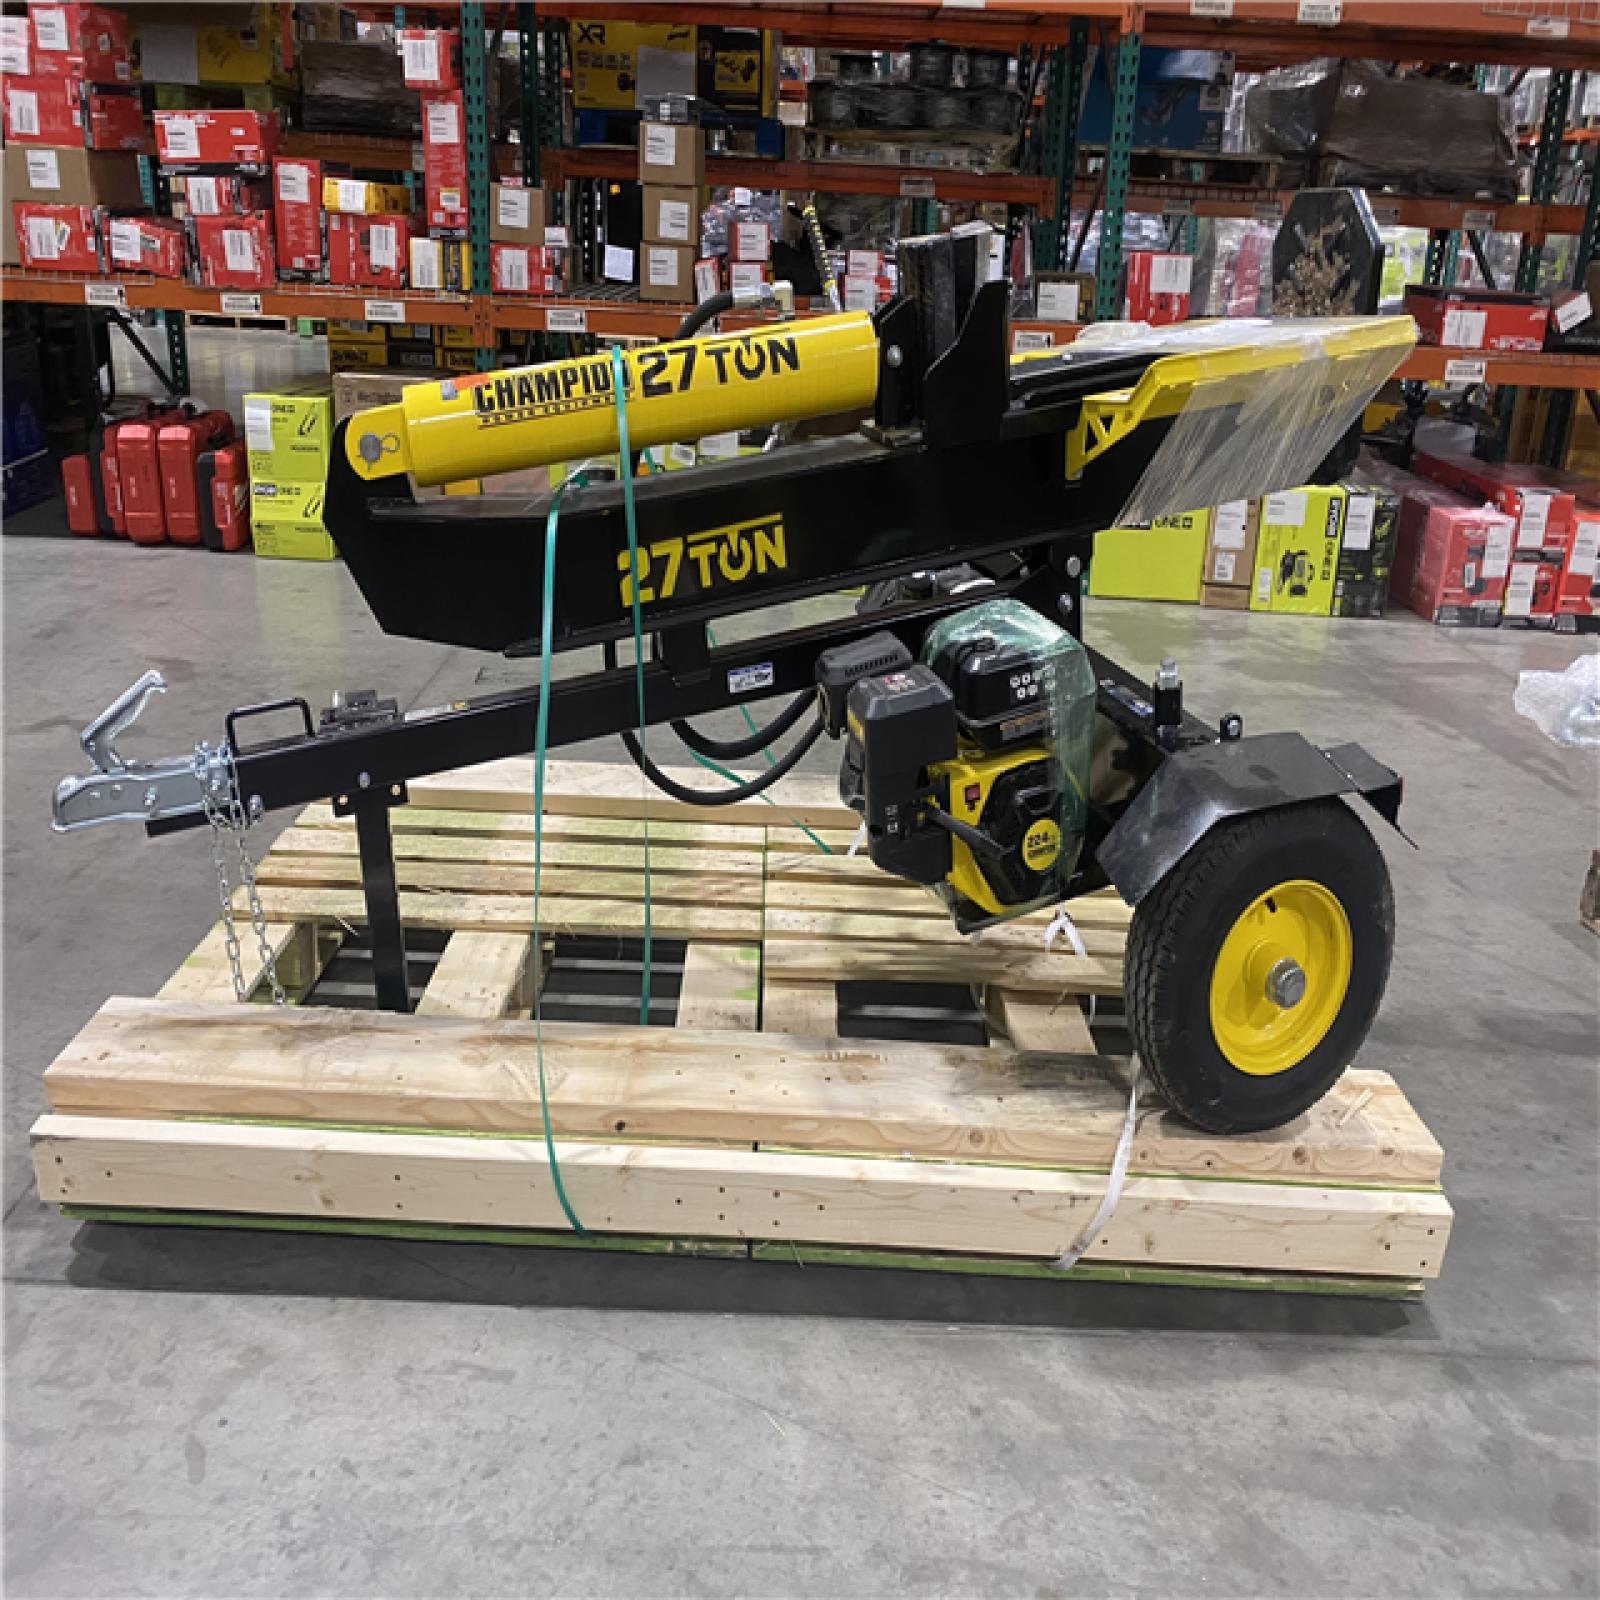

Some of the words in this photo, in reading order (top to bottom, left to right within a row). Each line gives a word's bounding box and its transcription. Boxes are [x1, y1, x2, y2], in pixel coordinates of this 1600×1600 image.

[637, 345, 697, 396] 27
[705, 337, 800, 384] TON
[617, 538, 683, 608] 27
[689, 522, 788, 588] TON
